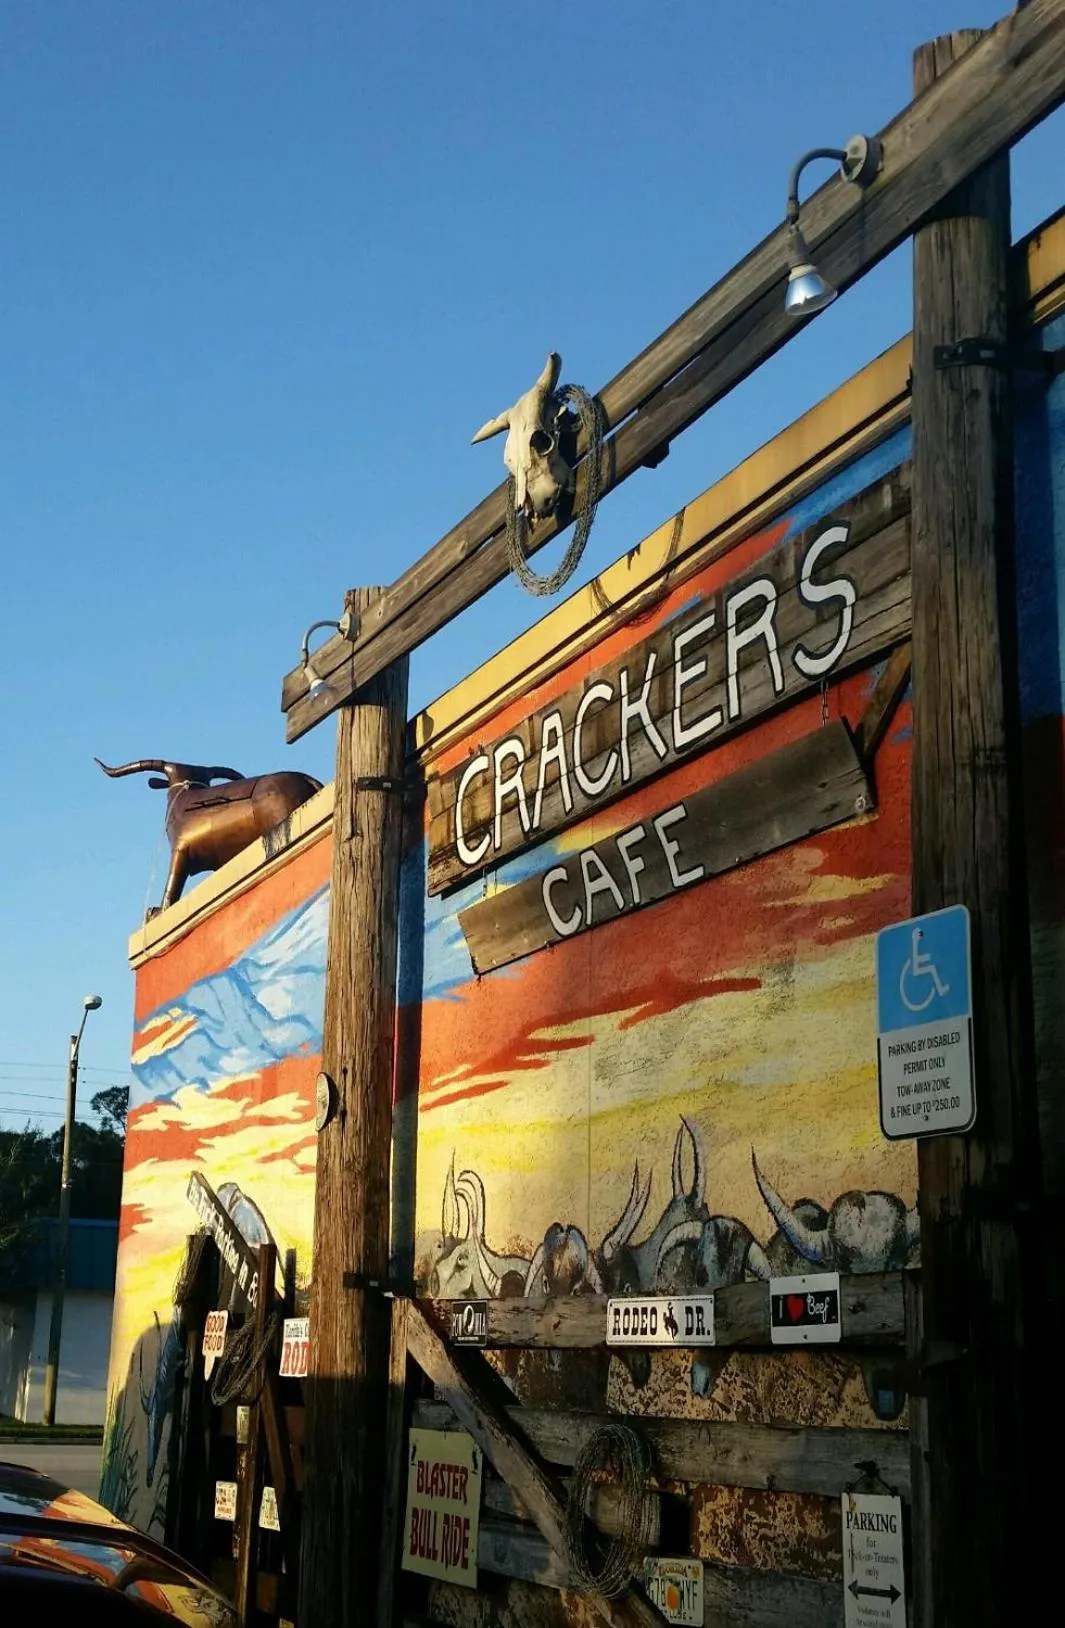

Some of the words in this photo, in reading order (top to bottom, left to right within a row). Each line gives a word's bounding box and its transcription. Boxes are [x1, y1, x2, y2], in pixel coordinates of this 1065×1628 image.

[455, 525, 857, 867] CRACKERS
[542, 804, 704, 937] CAFE
[888, 1040, 917, 1058] PARKING
[918, 1039, 927, 1050] BY
[927, 1031, 961, 1050] DISABLED
[903, 1059, 928, 1075] PERMIT
[929, 1055, 946, 1069] ONLY
[932, 1076, 951, 1092] ZONE
[896, 1104, 911, 1118] FINE
[912, 1102, 922, 1115] UP
[922, 1100, 931, 1113] TO
[612, 1306, 658, 1336] RODEO
[684, 1305, 711, 1336] DR.
[806, 1291, 831, 1324] Beef
[206, 1314, 224, 1333] GOOD
[204, 1334, 223, 1351] FOOD
[416, 1460, 469, 1505] BLASTER
[846, 1511, 897, 1534] PARKING
[410, 1507, 438, 1562] BULL
[440, 1513, 470, 1571] RIDE
